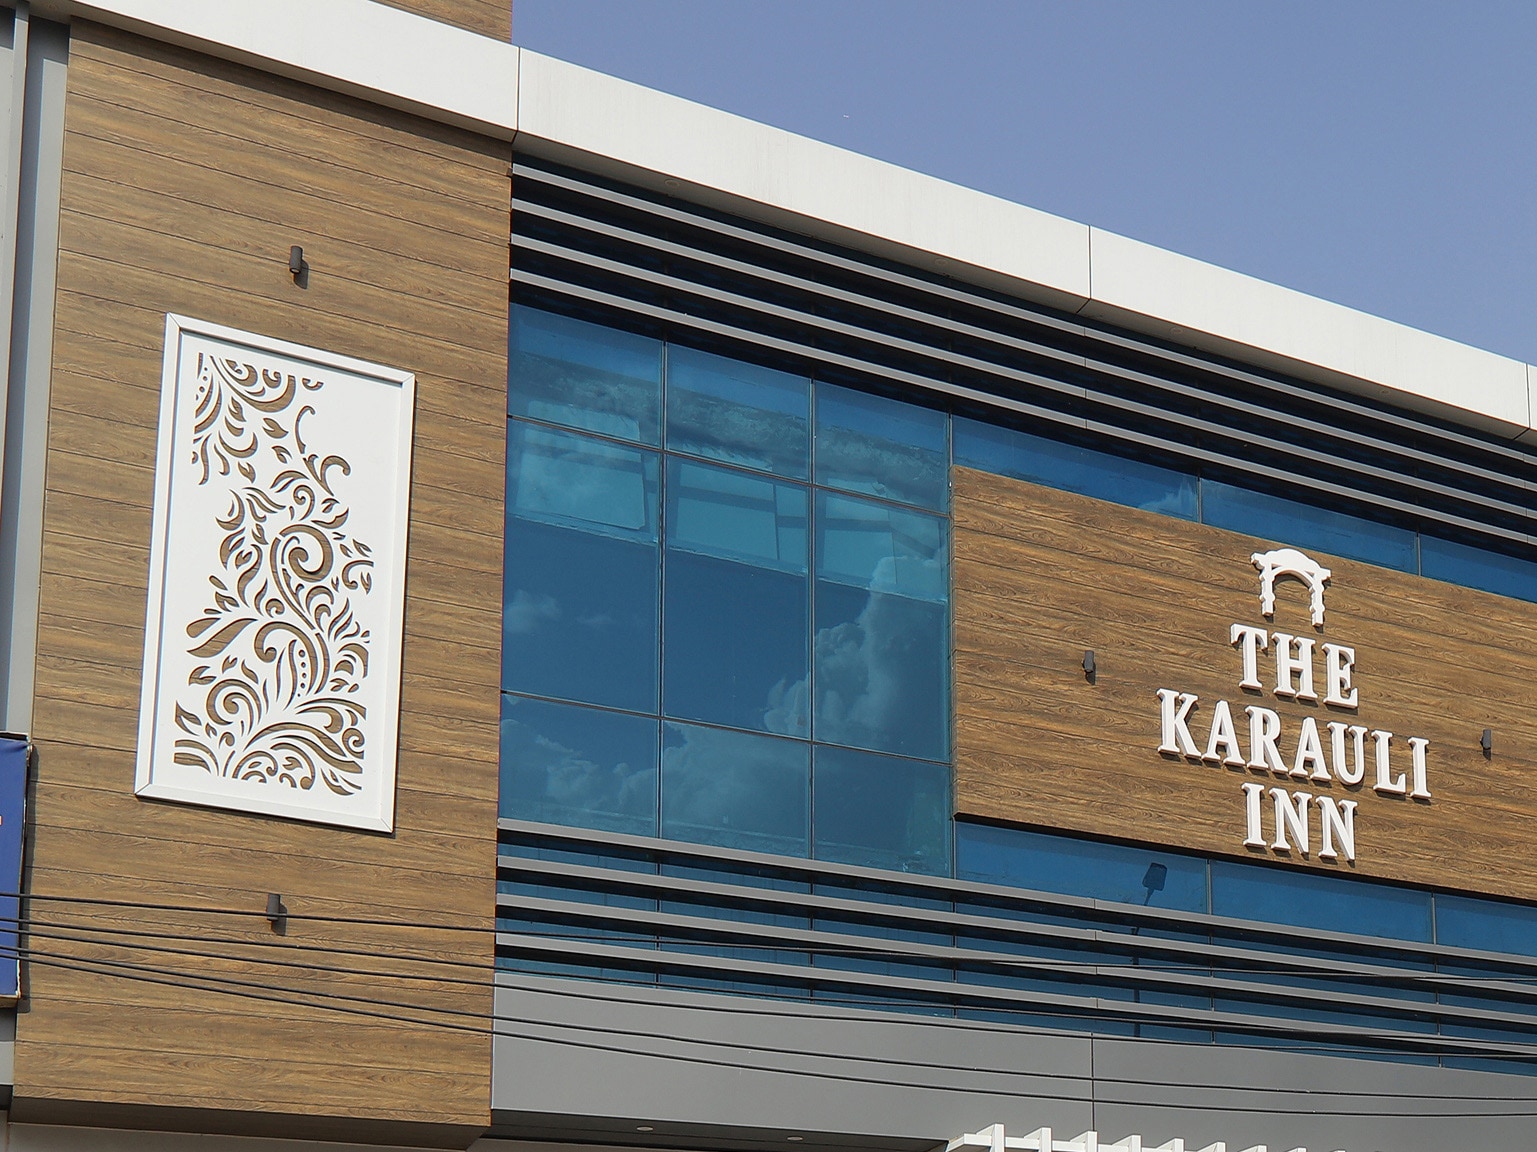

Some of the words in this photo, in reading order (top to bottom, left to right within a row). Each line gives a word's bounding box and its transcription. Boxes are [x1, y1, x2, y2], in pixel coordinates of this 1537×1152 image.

[1230, 623, 1358, 708] THE
[1157, 688, 1431, 799] KARAULI
[1241, 782, 1358, 861] INN
